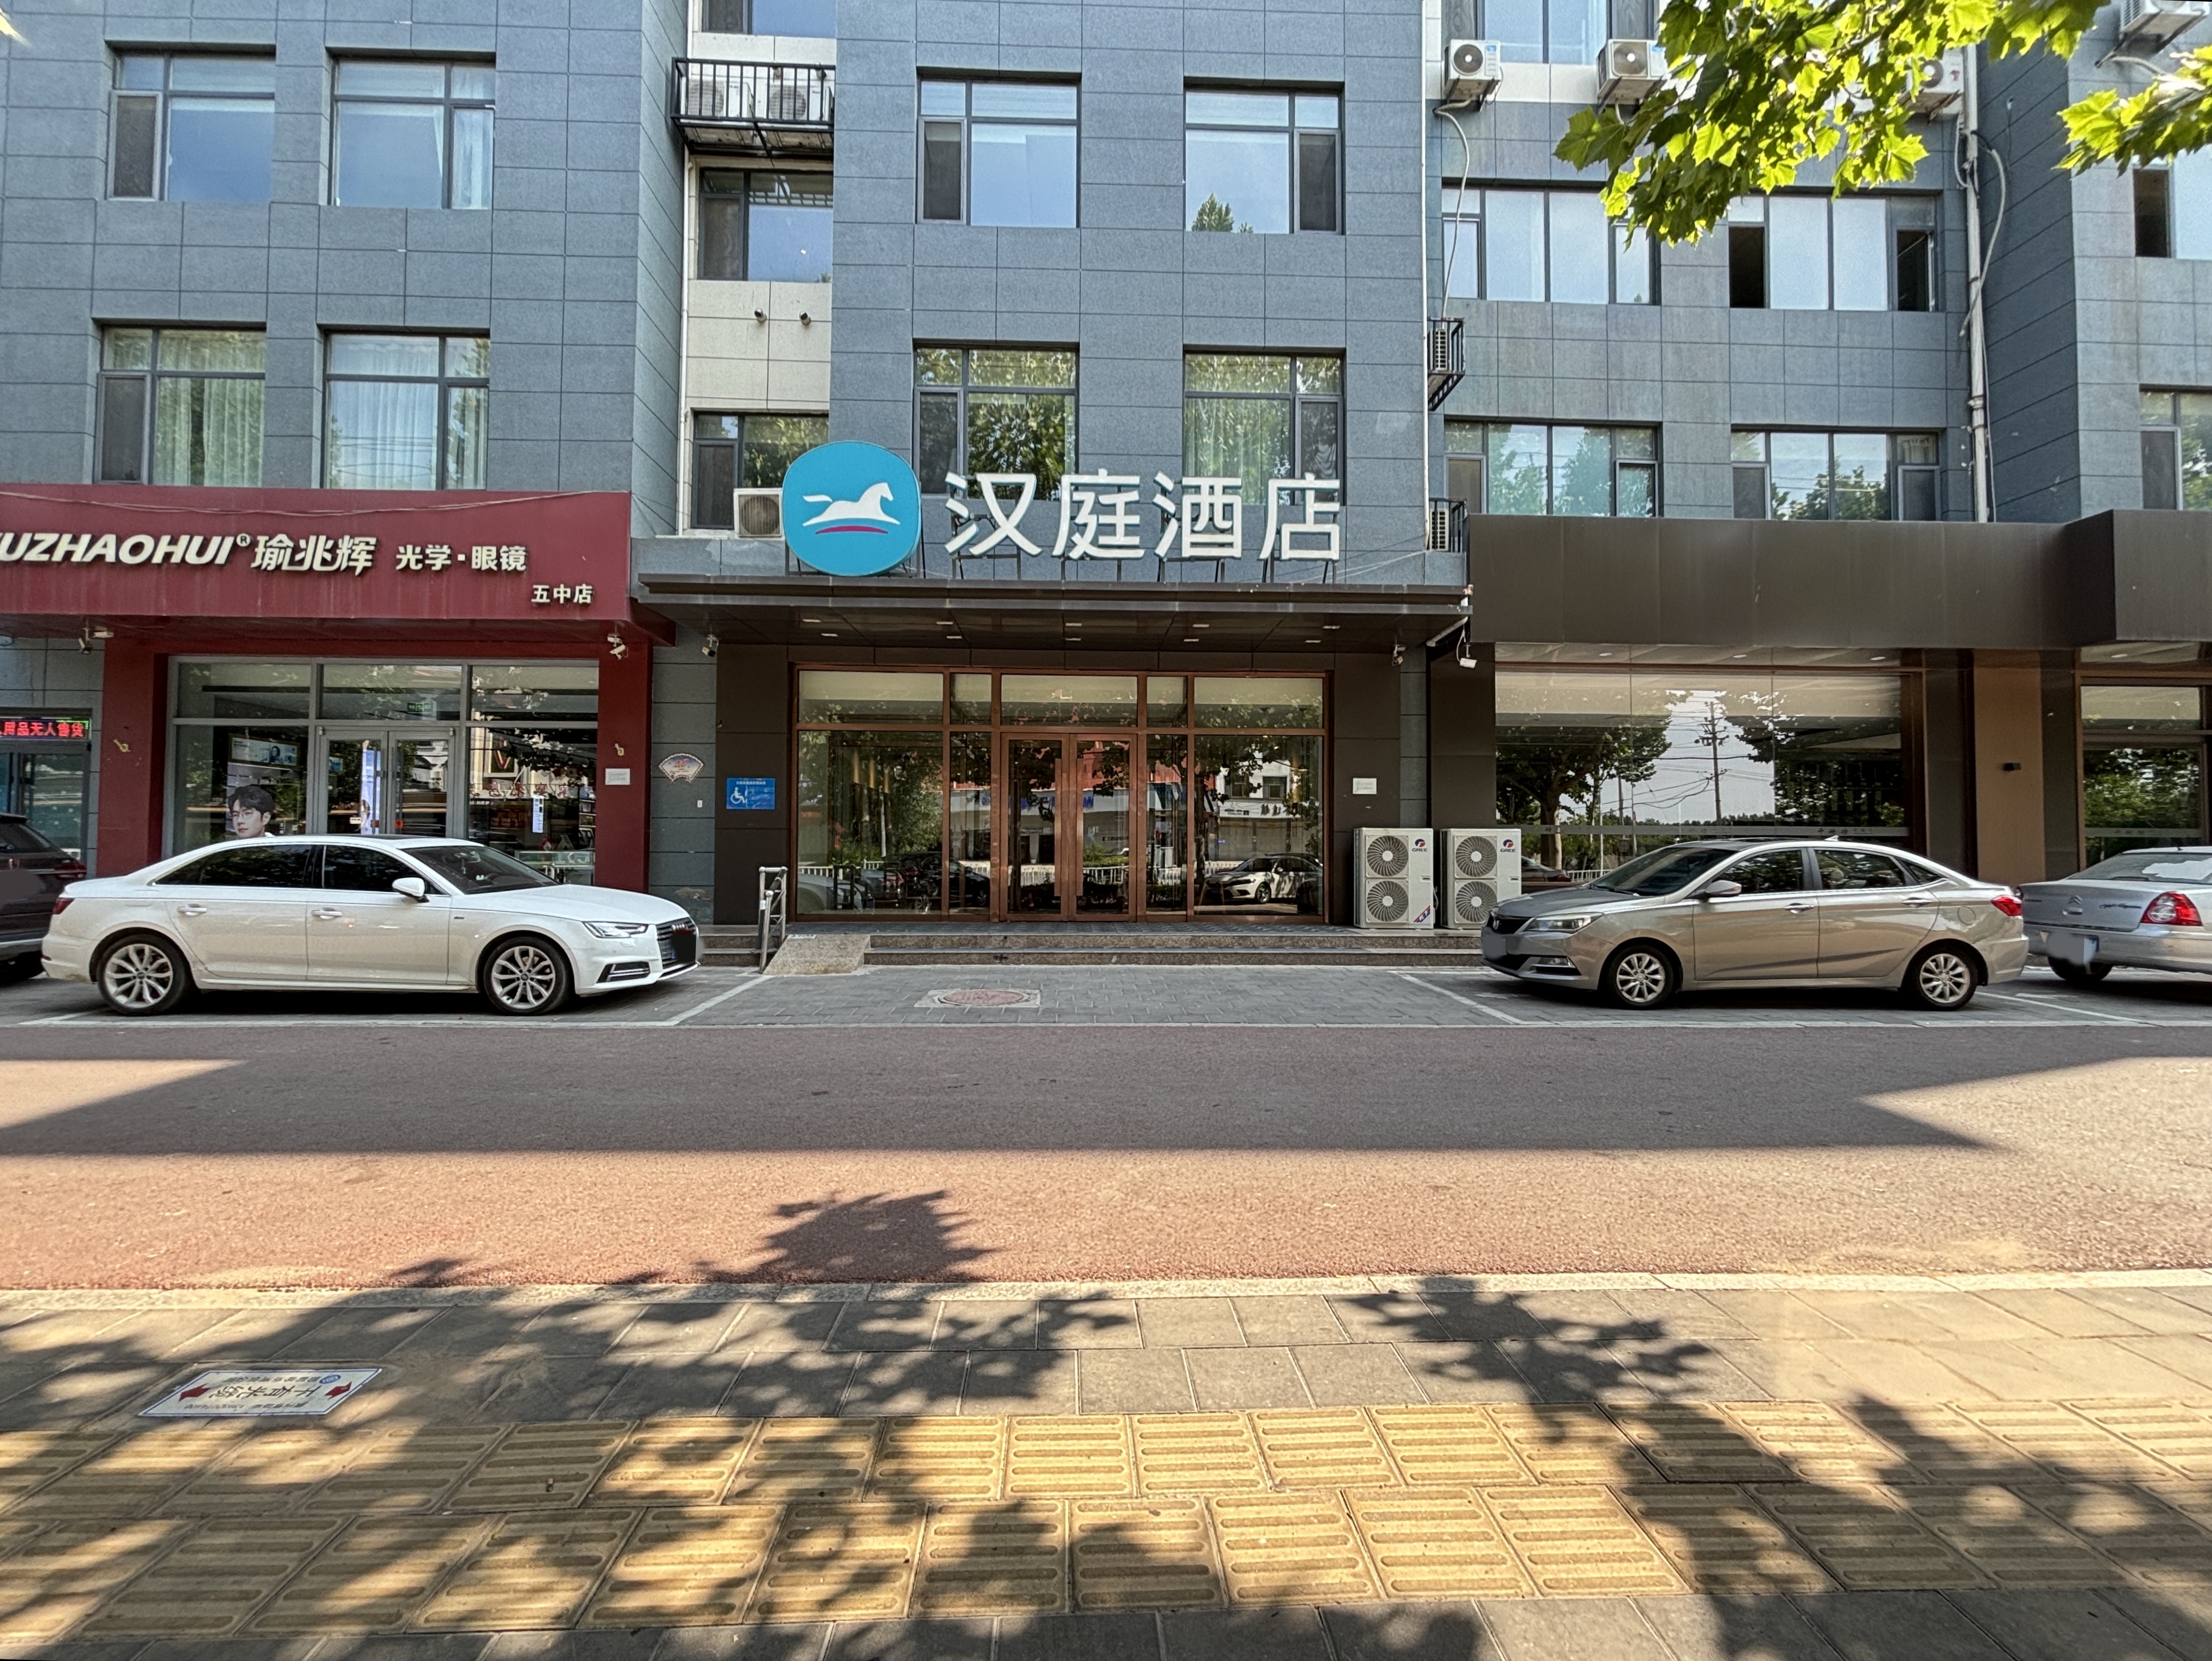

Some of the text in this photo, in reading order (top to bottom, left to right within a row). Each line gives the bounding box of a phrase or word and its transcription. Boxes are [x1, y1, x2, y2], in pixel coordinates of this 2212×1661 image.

[945, 469, 1340, 560] 汉庭酒店
[252, 534, 376, 575] 瑜兆辉
[531, 584, 592, 604] 五中店
[0, 722, 83, 737] 用品无人售货
